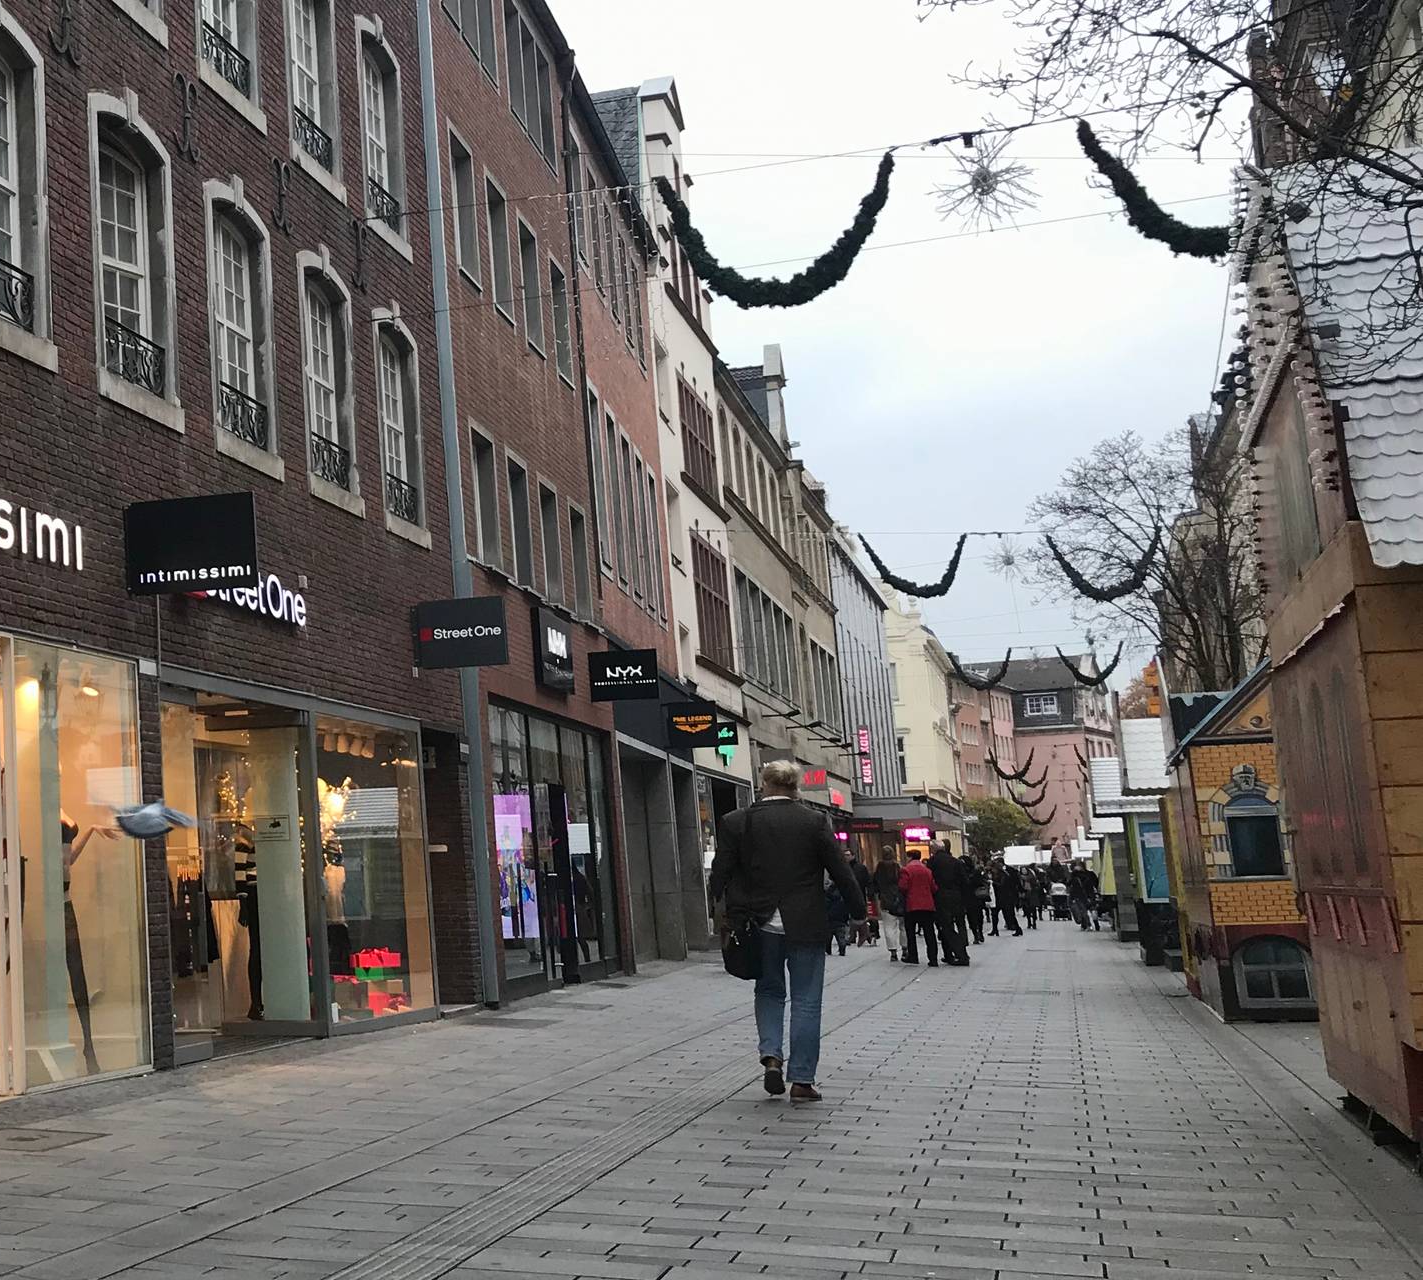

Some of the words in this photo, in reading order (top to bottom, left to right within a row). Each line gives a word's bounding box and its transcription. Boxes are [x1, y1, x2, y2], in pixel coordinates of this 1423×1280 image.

[139, 564, 251, 584] intimissimi
[266, 573, 307, 627] One
[433, 627, 473, 640] Street
[474, 625, 502, 637] One
[606, 665, 643, 679] NYX
[687, 714, 713, 722] LEGEND
[858, 729, 869, 753] KULT
[861, 758, 873, 784] KULT
